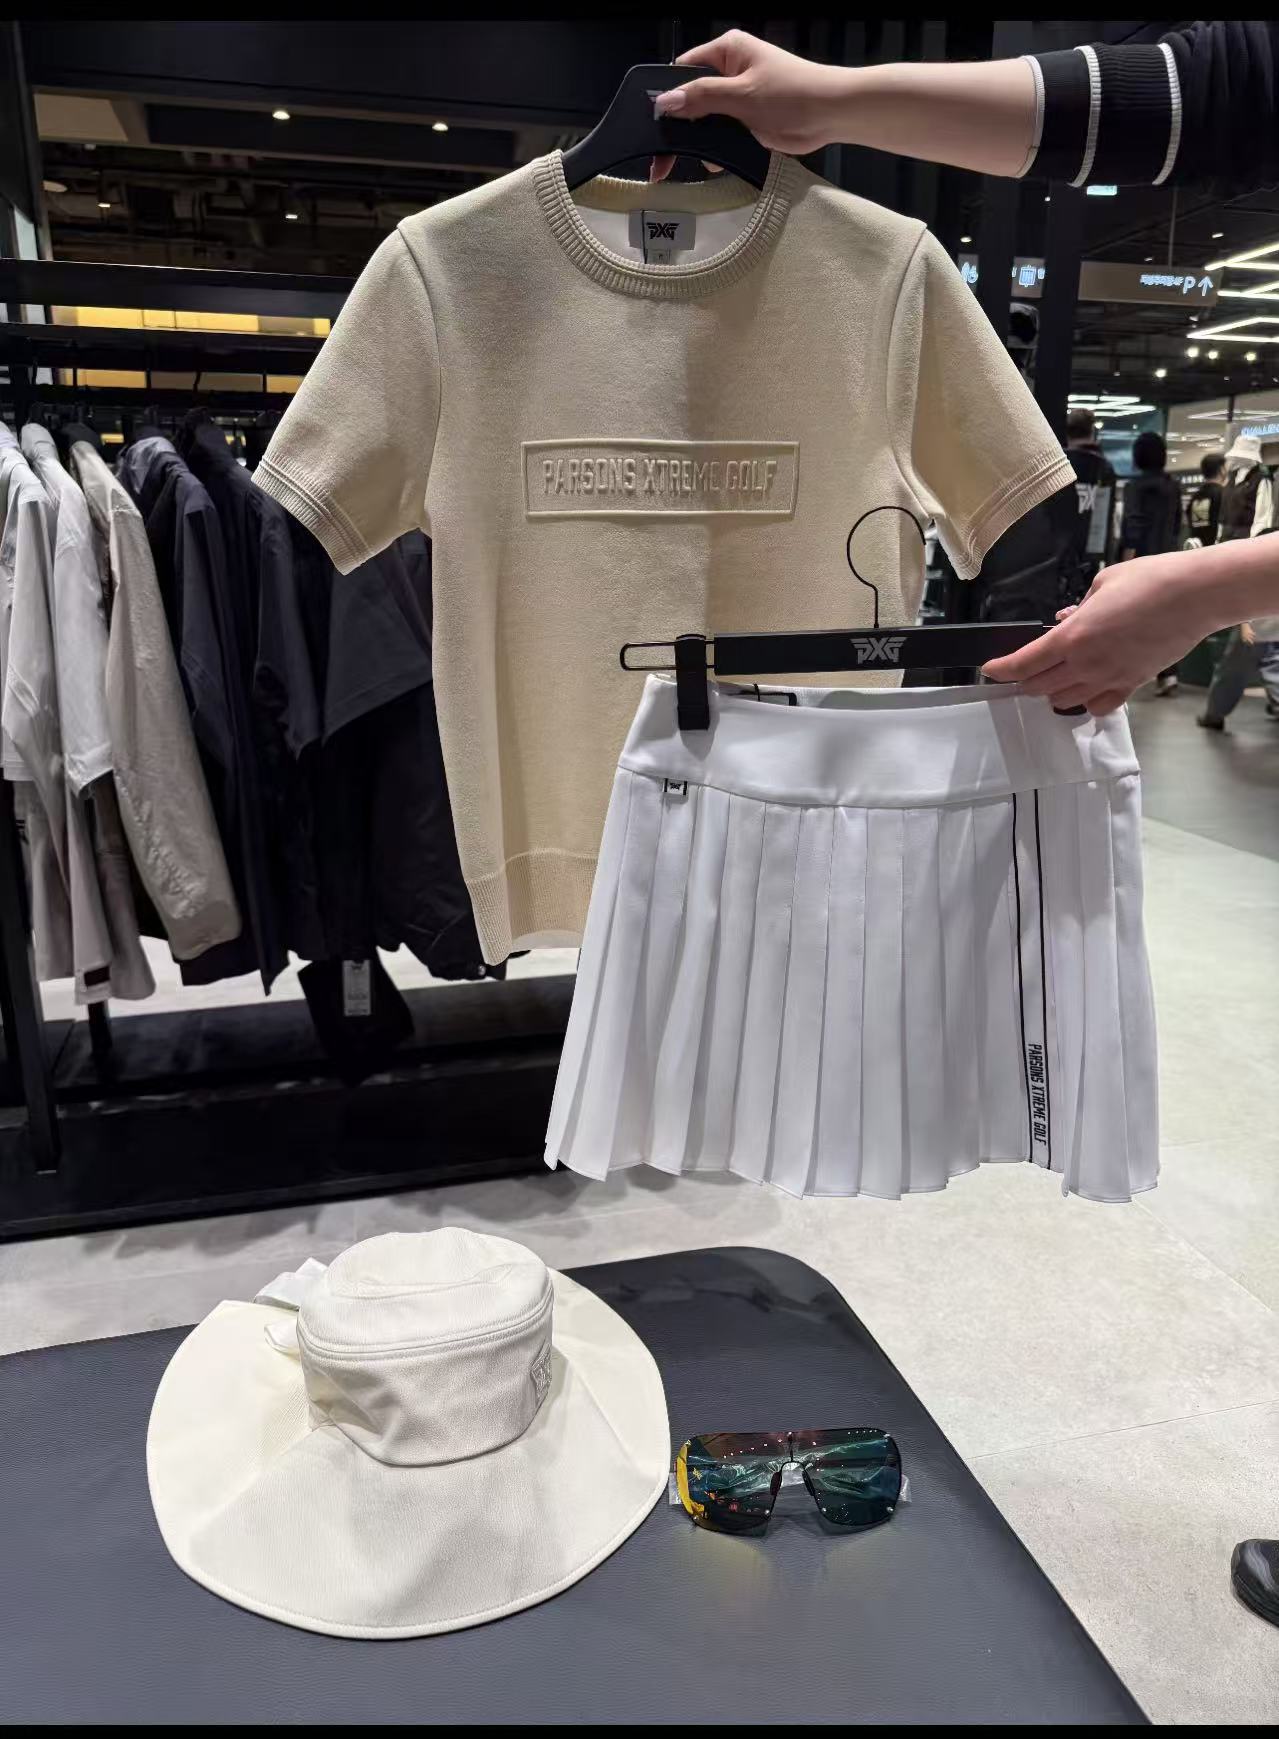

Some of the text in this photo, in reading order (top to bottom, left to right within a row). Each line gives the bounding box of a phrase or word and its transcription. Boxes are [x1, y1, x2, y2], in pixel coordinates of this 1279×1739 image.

[646, 222, 680, 240] PXG
[543, 458, 777, 496] PARSONS XTREME GOLF
[850, 637, 908, 664] PXG
[1028, 1043, 1047, 1146] PARSONS XTREME GOLF
